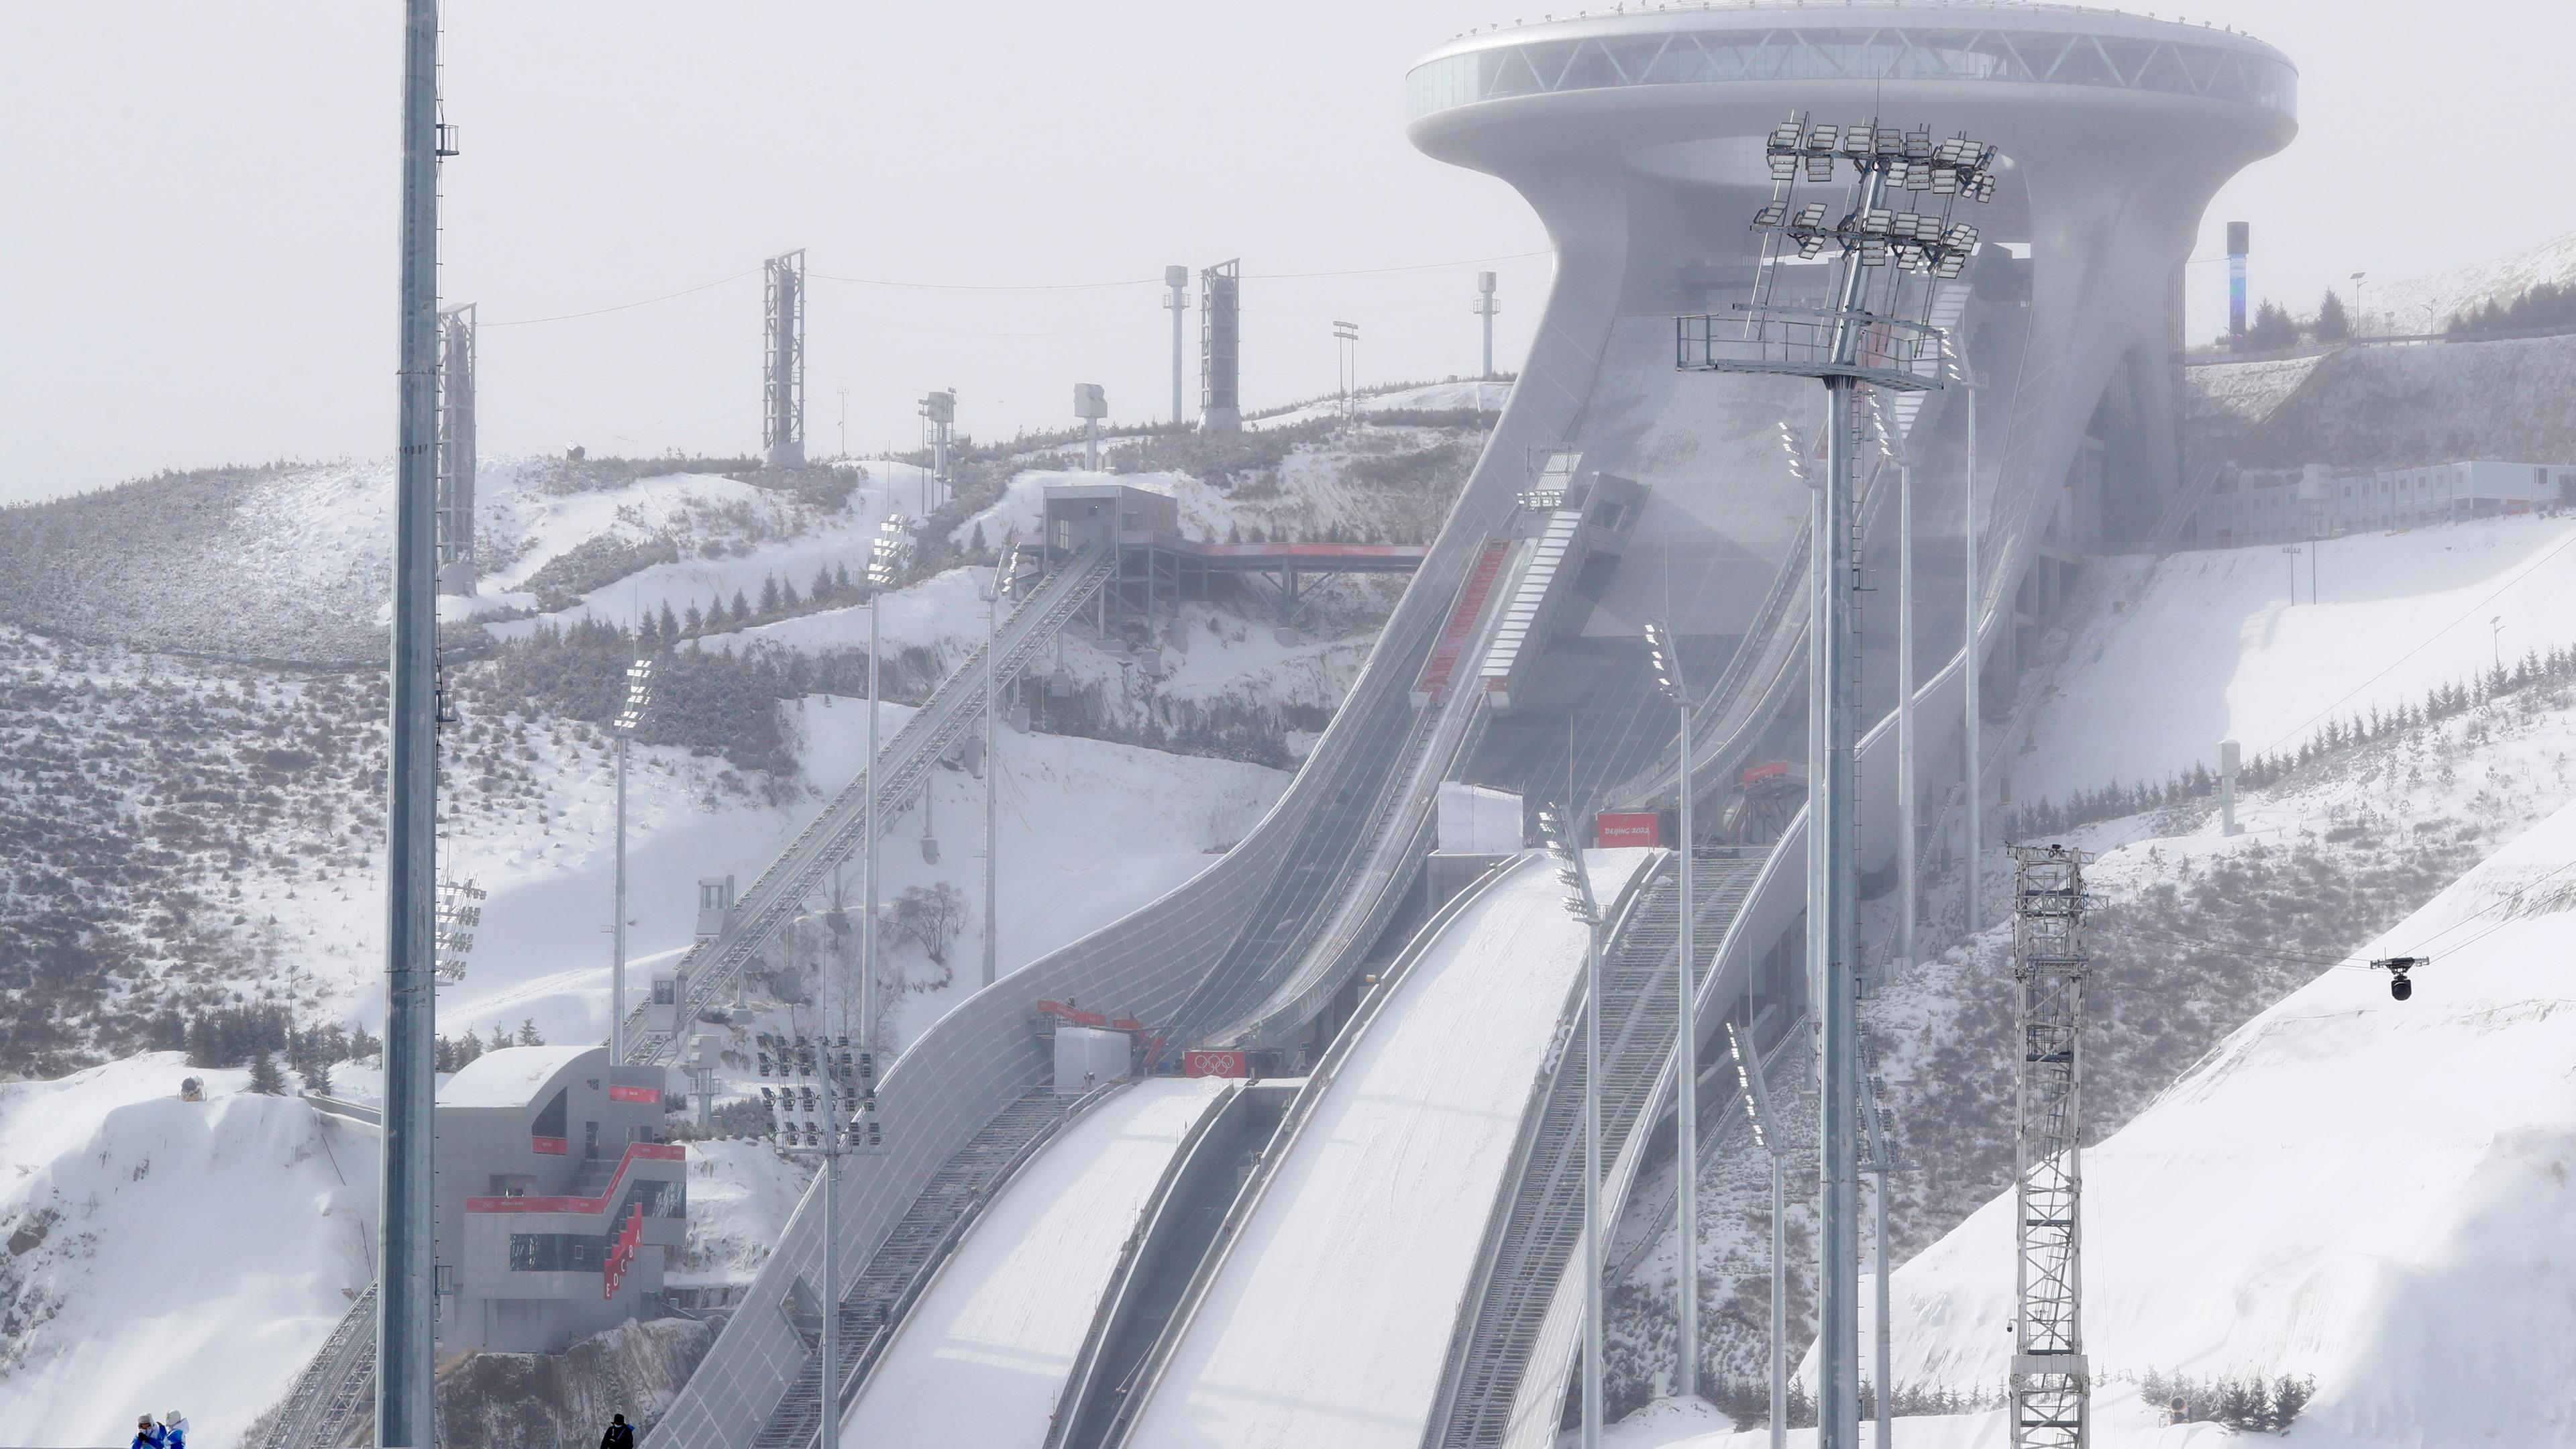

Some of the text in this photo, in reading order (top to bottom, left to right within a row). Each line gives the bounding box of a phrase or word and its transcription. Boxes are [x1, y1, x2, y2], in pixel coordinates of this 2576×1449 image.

[1605, 827, 1630, 836] BEIJING
[635, 1229, 641, 1244] A
[629, 1244, 633, 1258] B
[621, 1258, 625, 1273] C
[613, 1273, 619, 1287] D
[606, 1283, 610, 1297] E
